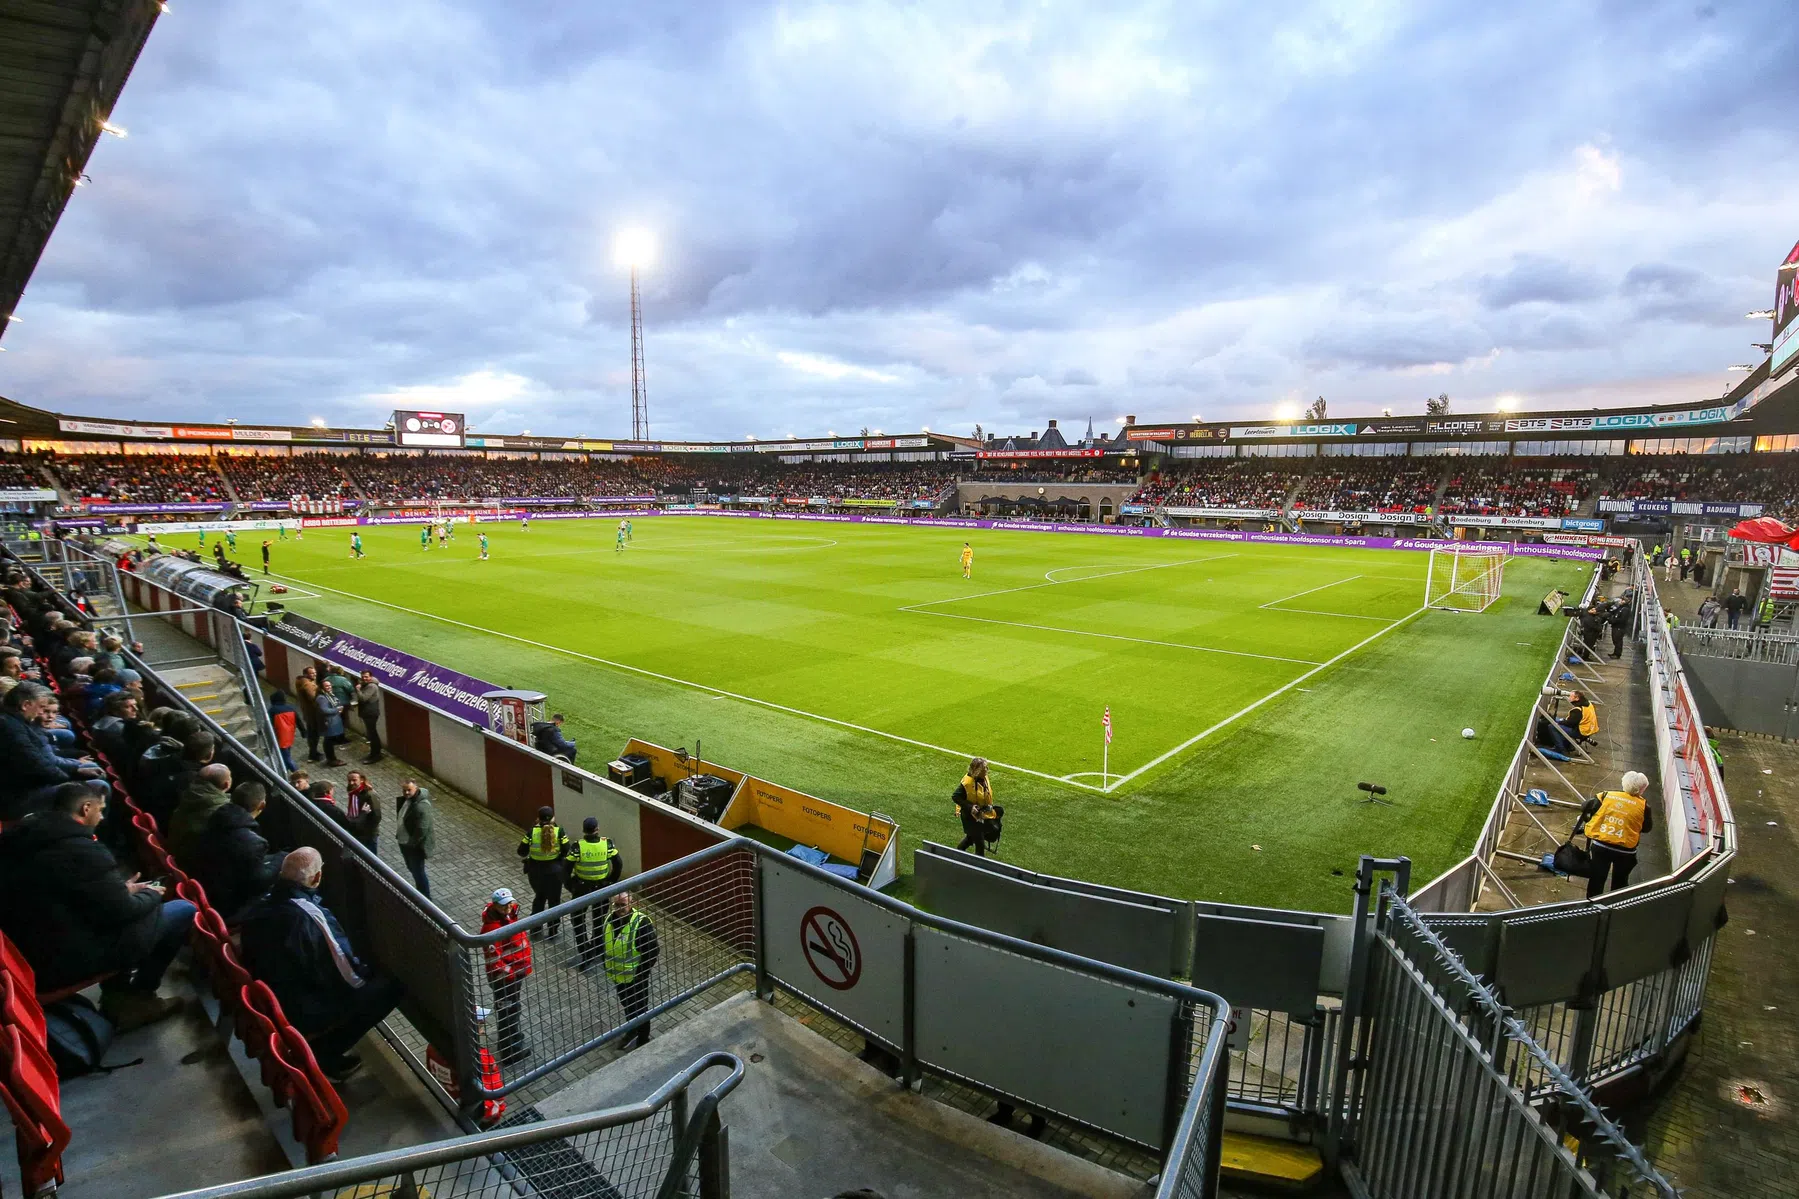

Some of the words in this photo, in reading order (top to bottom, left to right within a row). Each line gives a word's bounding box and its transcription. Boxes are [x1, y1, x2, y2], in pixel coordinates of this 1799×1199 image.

[1595, 414, 1656, 427] LOGIX
[1689, 408, 1728, 421] LOGIX
[1520, 419, 1546, 427] BTS
[1563, 418, 1592, 426] BTS
[1296, 424, 1351, 435] LOGIX
[1600, 500, 1635, 512] WOONING
[1671, 502, 1704, 514] WOONING
[1338, 512, 1369, 520] Dosign
[1380, 513, 1412, 522] Dosign
[1450, 516, 1492, 525] Roodenburg
[1501, 517, 1545, 526] Roodenburg
[1565, 519, 1600, 528] bictgroep
[1020, 523, 1052, 531] verzekeringen
[1200, 530, 1243, 540] verzekeringen
[1250, 534, 1288, 542] enthousiaste
[1288, 535, 1331, 545] hoofdsponsor
[1344, 538, 1366, 547] Sparta
[1554, 535, 1587, 543] HURKENS
[1597, 537, 1625, 545] HURKENS
[1415, 541, 1443, 550] Goudse
[1514, 545, 1561, 556] enthousiaste
[1561, 548, 1602, 559] hoofdsponso
[338, 642, 348, 654] de
[345, 645, 366, 662] Goudse
[363, 654, 408, 677] verzekeringen
[418, 673, 429, 687] de
[427, 677, 456, 697] Goudse
[756, 789, 783, 804] FOTOPERS
[802, 805, 832, 822] FOTOPERS
[1604, 815, 1624, 826] FOTO
[853, 823, 886, 841] FOTOPERS
[1600, 823, 1624, 838] 824
